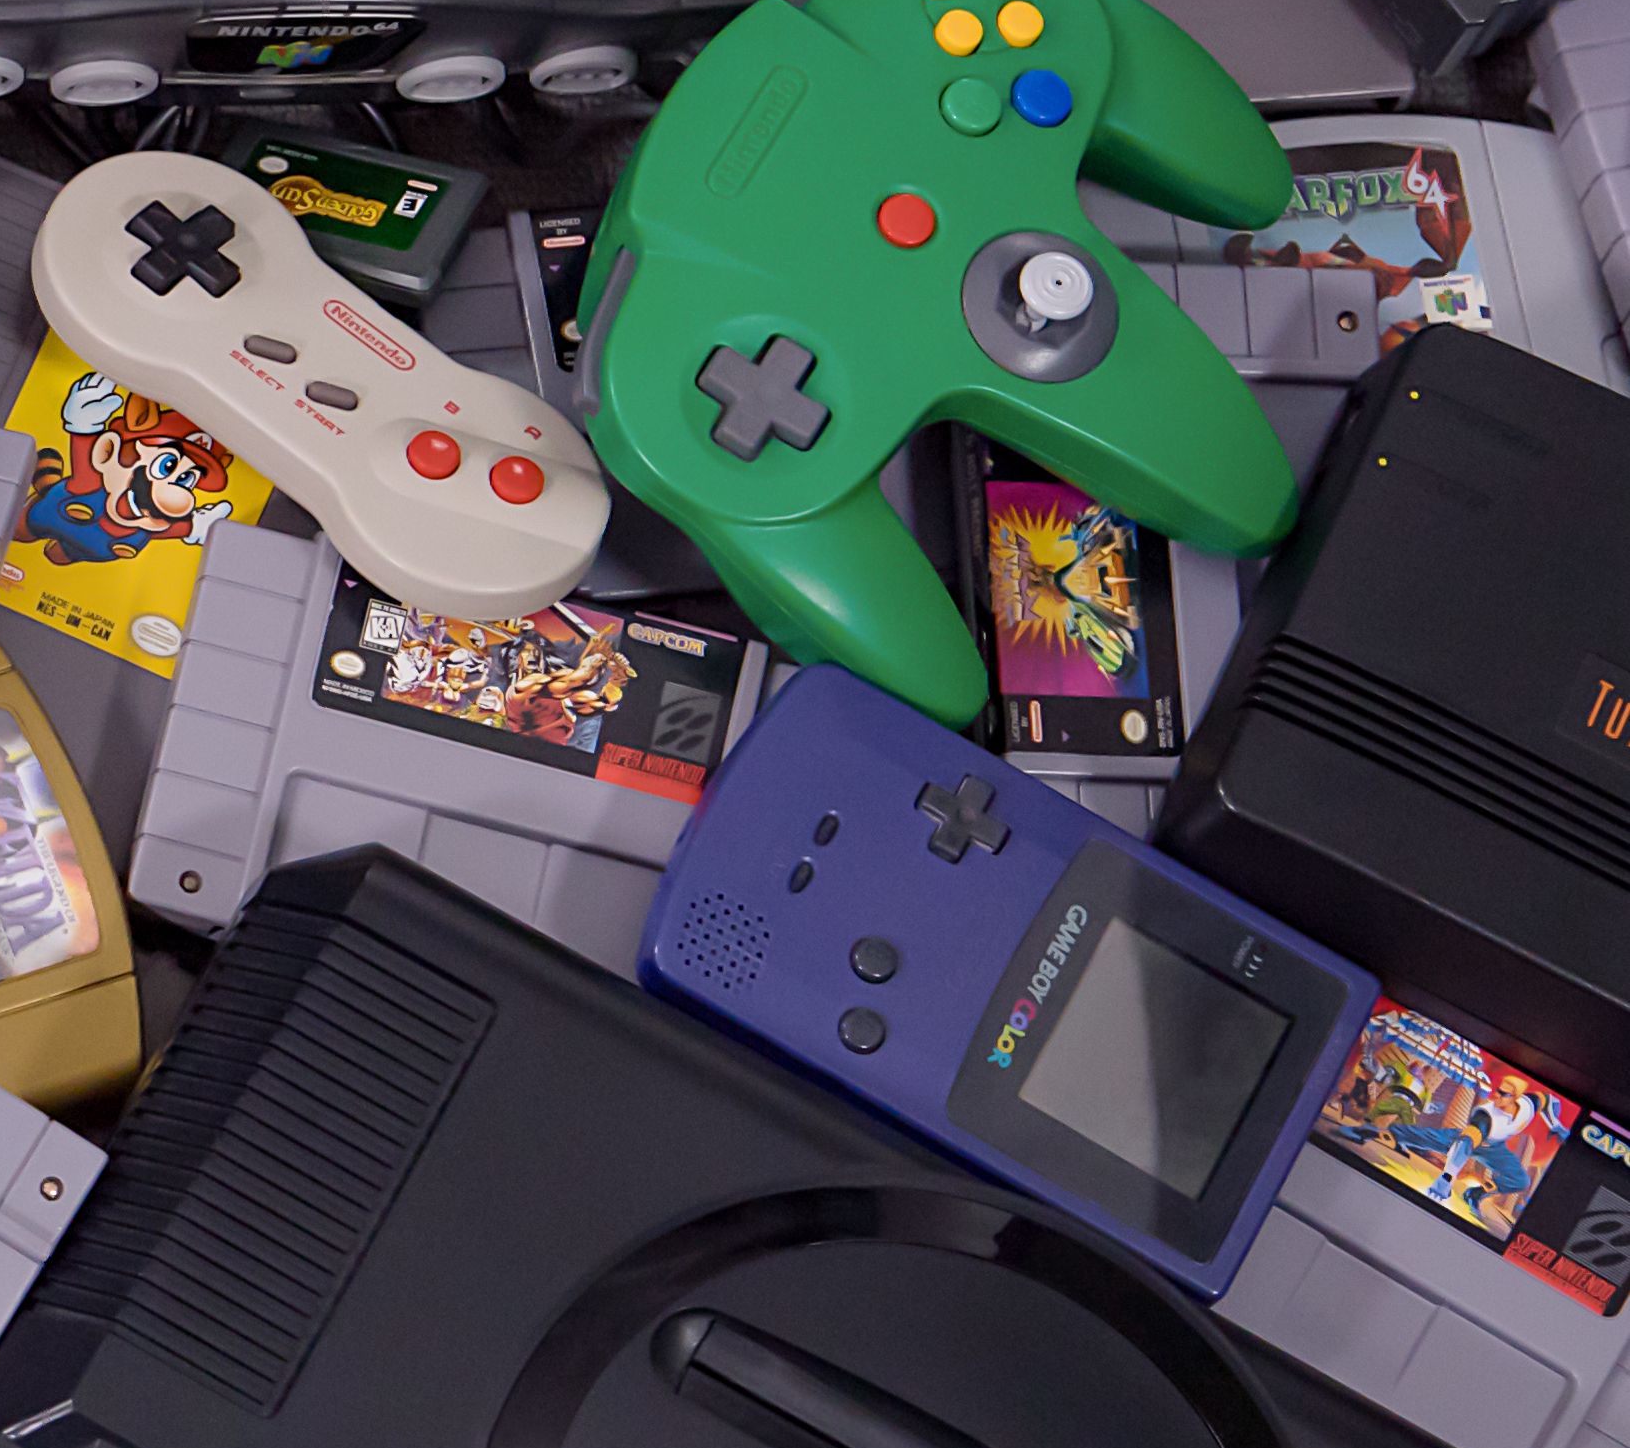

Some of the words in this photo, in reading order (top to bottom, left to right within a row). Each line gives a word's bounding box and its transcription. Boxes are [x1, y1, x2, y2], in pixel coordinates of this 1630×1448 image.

[217, 26, 370, 37] NINTENDO
[328, 303, 408, 368] Nintendo
[229, 349, 286, 392] SELECT
[293, 397, 346, 438] START
[627, 623, 705, 656] CAPCOM
[1054, 903, 1087, 964] GAME
[1028, 961, 1054, 1005] BOY
[986, 999, 1036, 1069] COLOR
